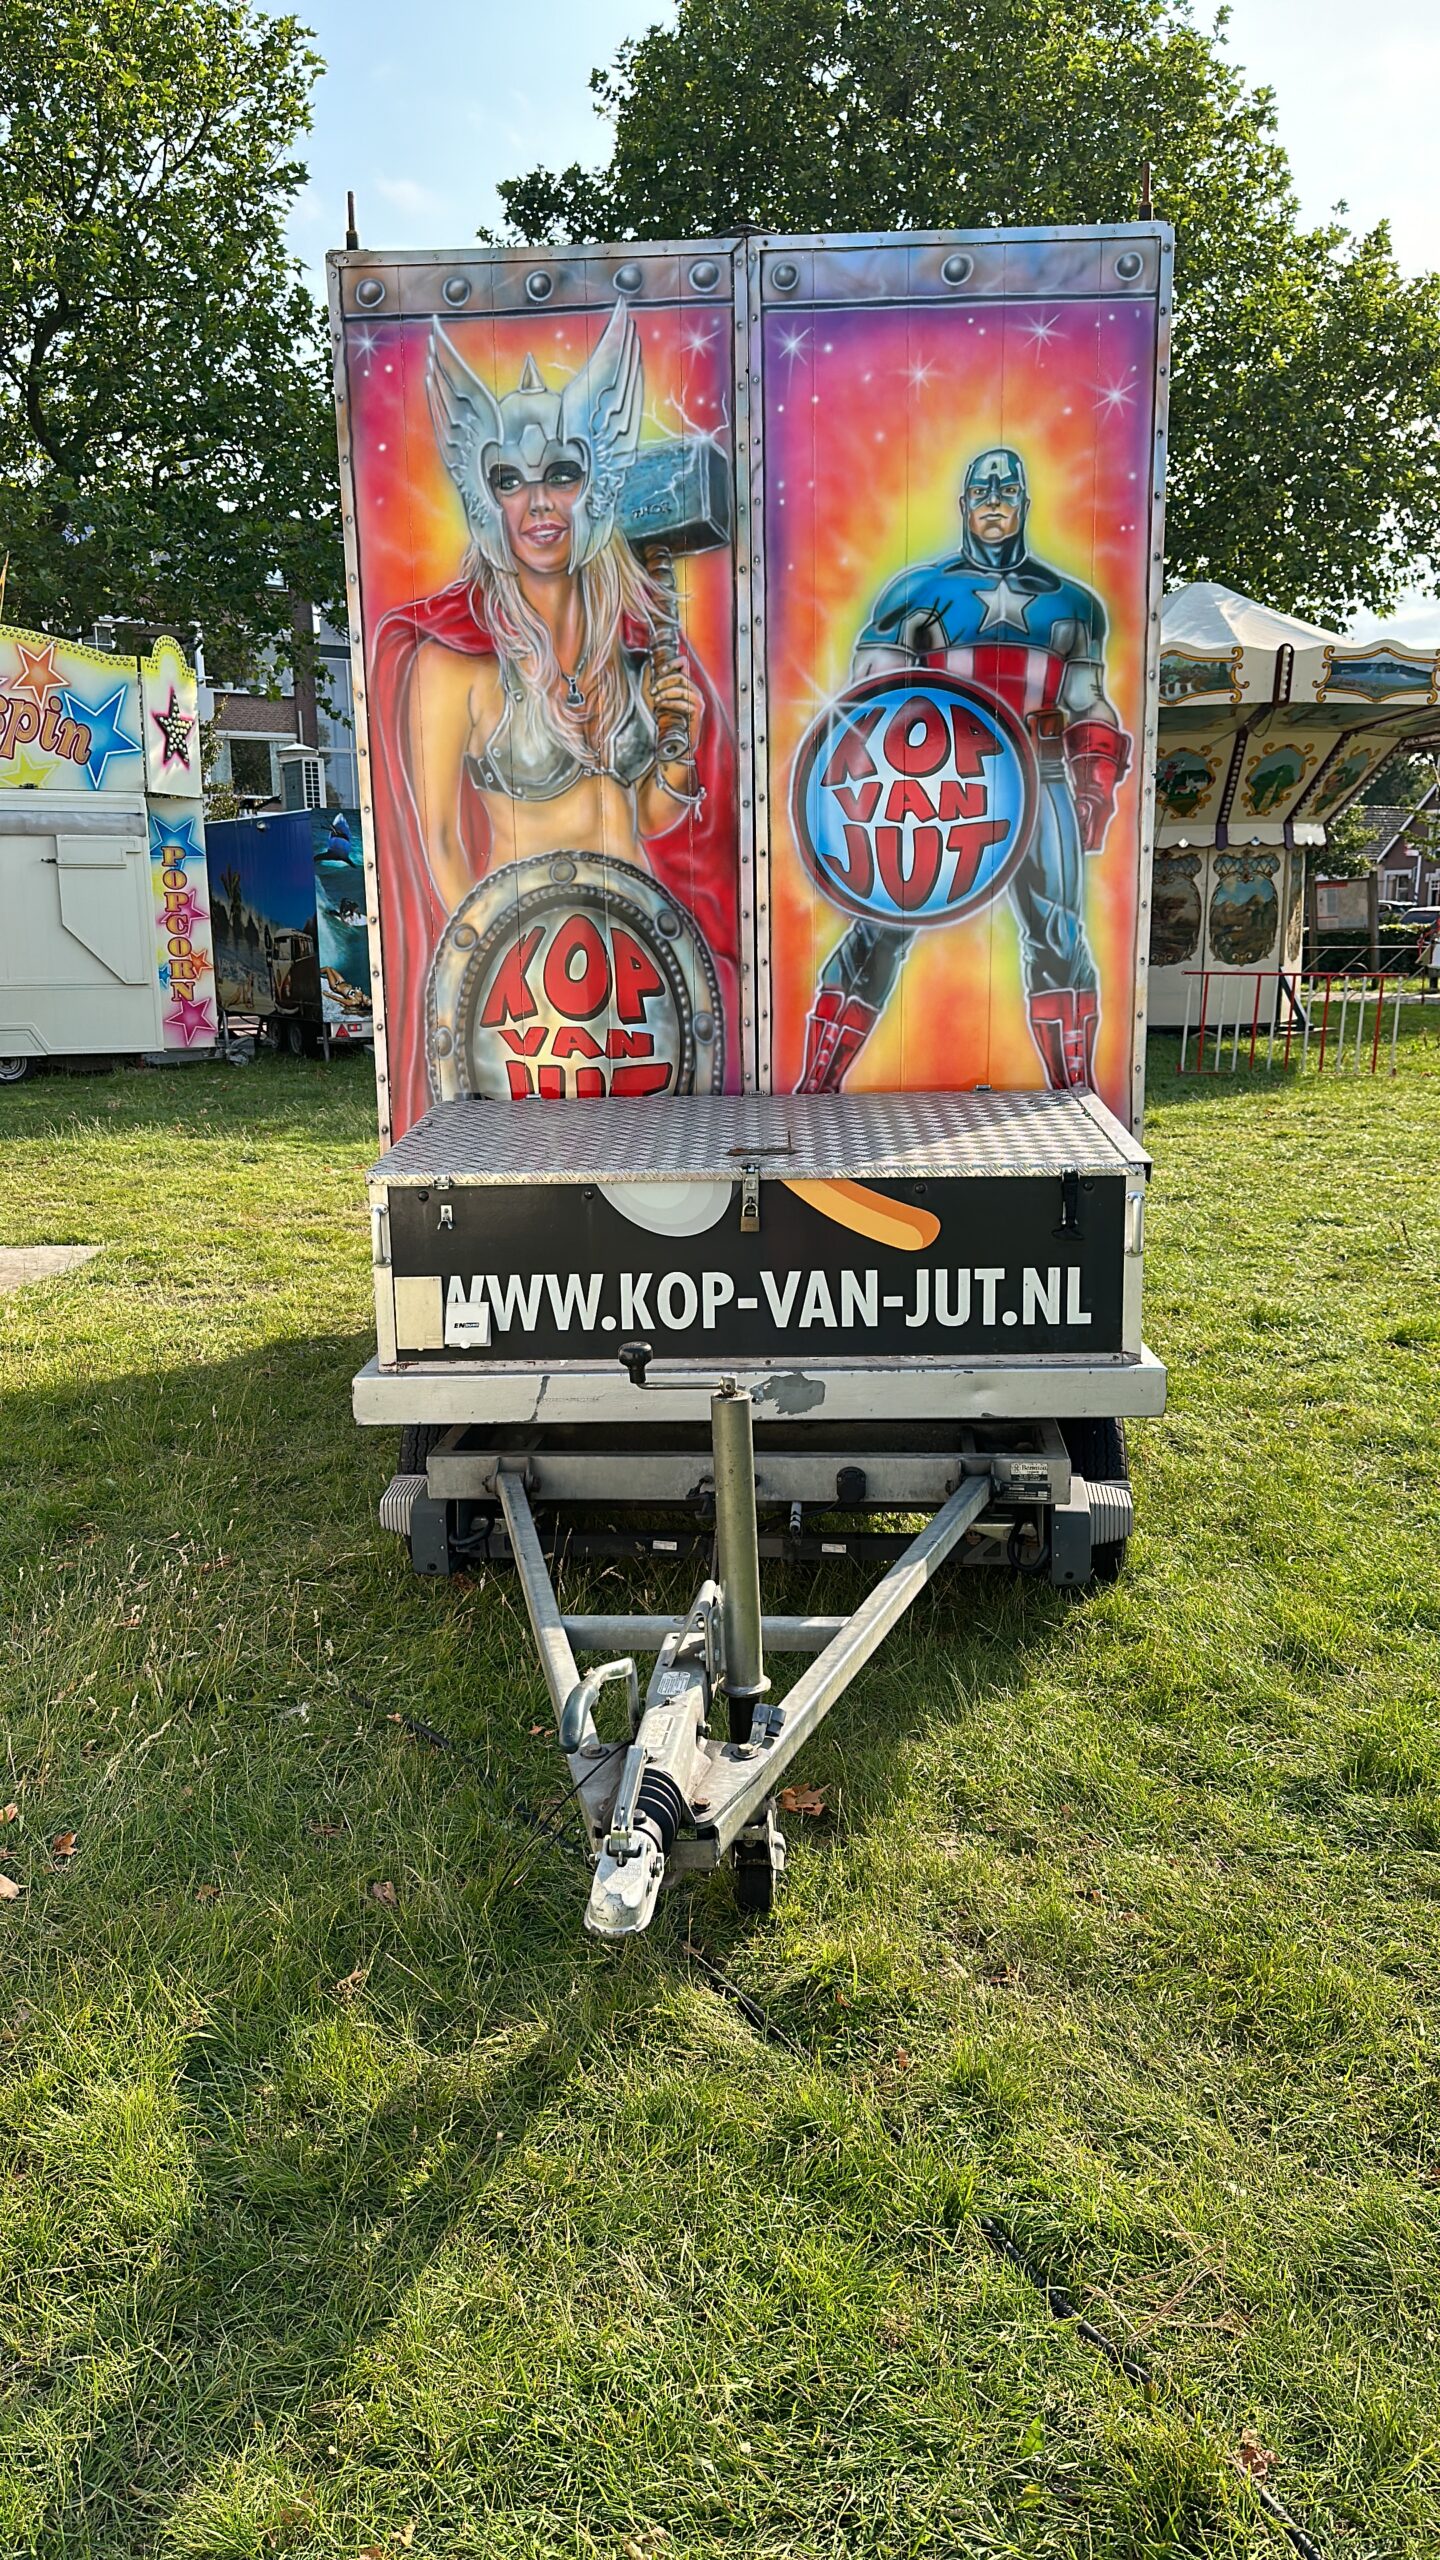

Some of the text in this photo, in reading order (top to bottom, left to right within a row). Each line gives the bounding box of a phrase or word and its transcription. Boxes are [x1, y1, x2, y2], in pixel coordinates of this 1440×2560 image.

[631, 501, 672, 519] THOR
[820, 695, 1005, 787] KOP
[832, 779, 988, 823] VAN
[820, 819, 1011, 911] JUT
[161, 845, 196, 1002] POPCORN
[480, 913, 666, 1028] KOP
[498, 1026, 655, 1059] VAN
